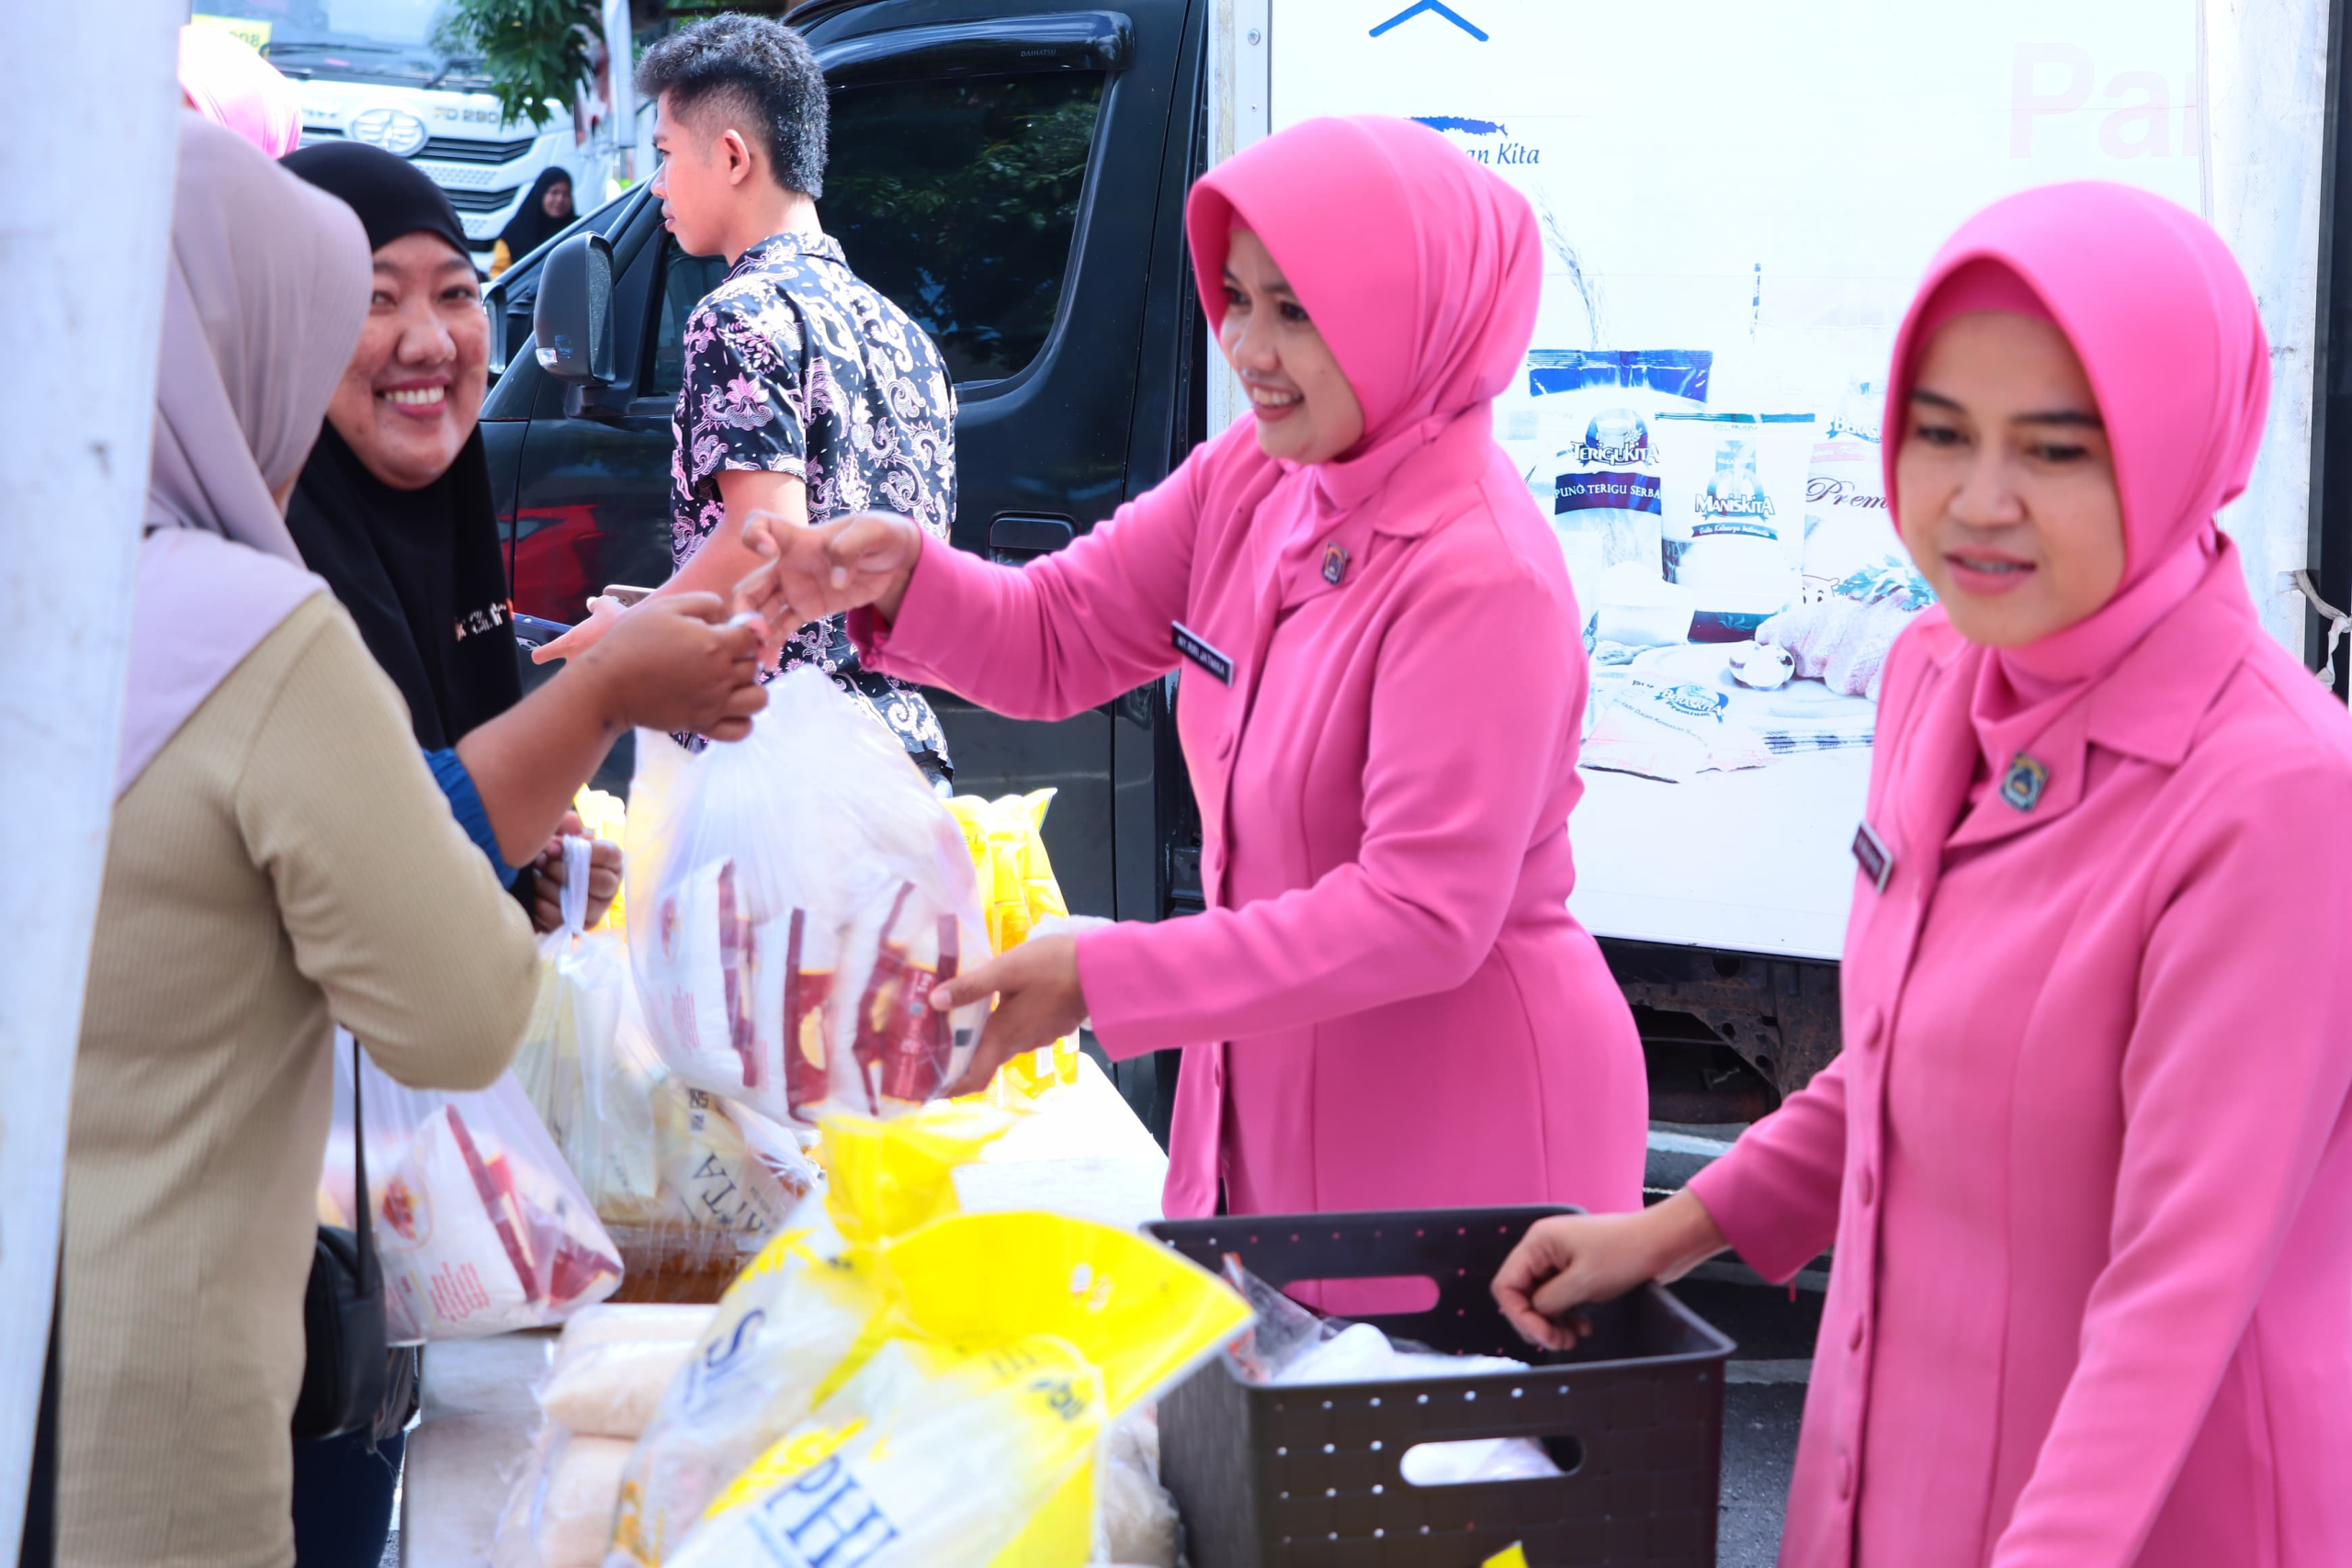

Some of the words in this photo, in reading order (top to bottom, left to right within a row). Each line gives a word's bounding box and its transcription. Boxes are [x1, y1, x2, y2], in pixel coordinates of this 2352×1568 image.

[1021, 49, 1057, 57] DAIHATSU
[1498, 142, 1540, 164] Kita
[1588, 483, 1627, 494] TERIGU
[1630, 484, 1661, 499] SERBA
